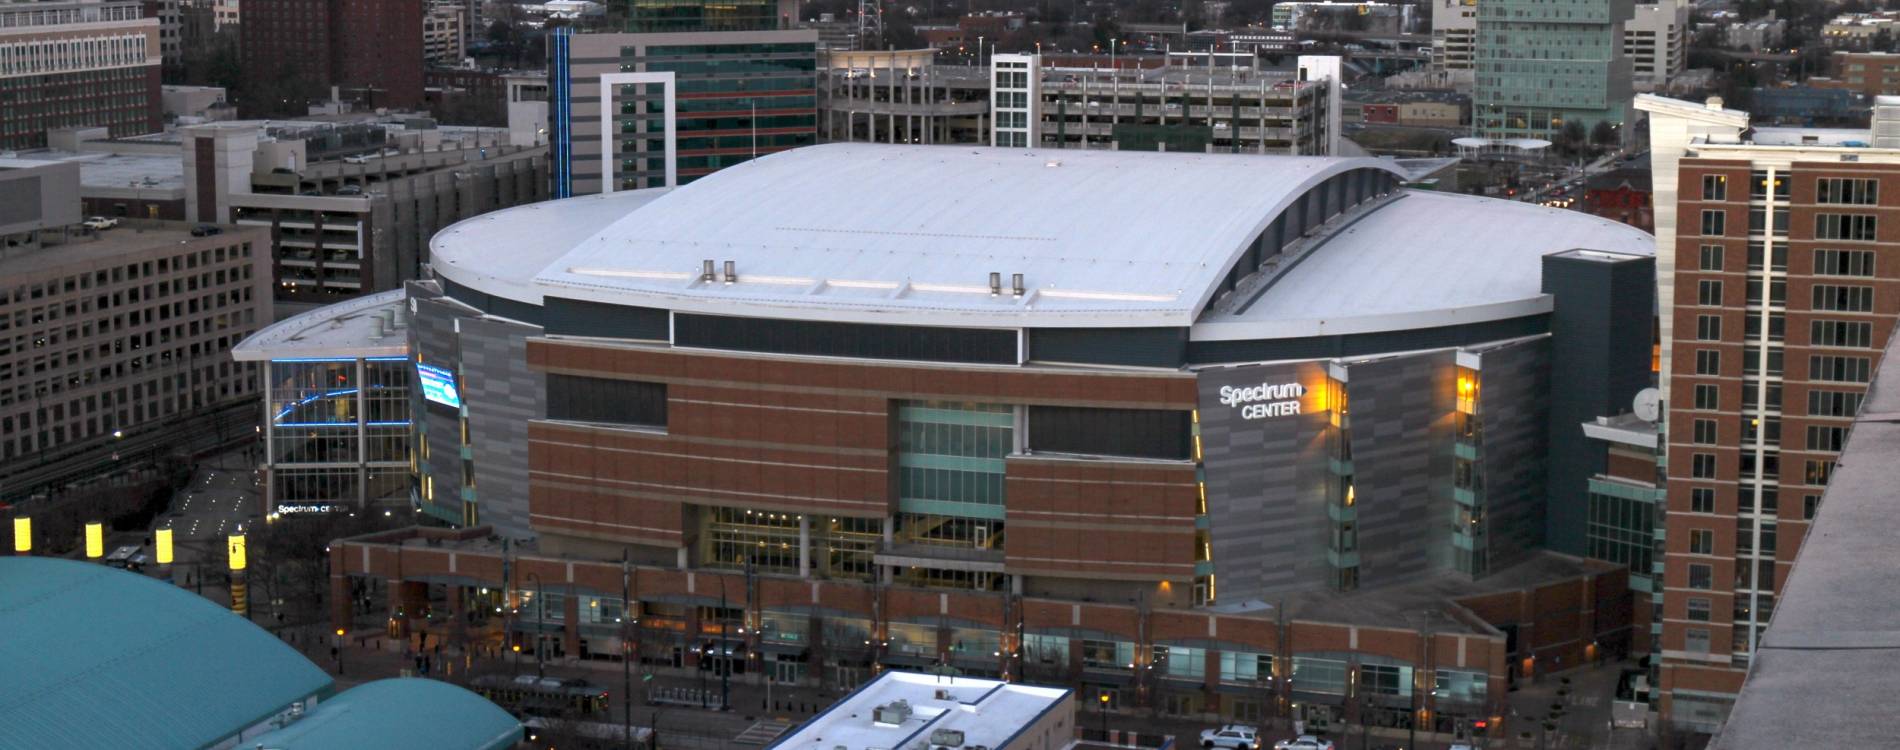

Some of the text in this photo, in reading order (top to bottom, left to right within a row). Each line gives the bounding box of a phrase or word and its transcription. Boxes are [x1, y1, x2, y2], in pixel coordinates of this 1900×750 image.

[1219, 382, 1302, 408] Spectrum
[1241, 400, 1300, 420] CENTER
[278, 504, 317, 515] Spectrum
